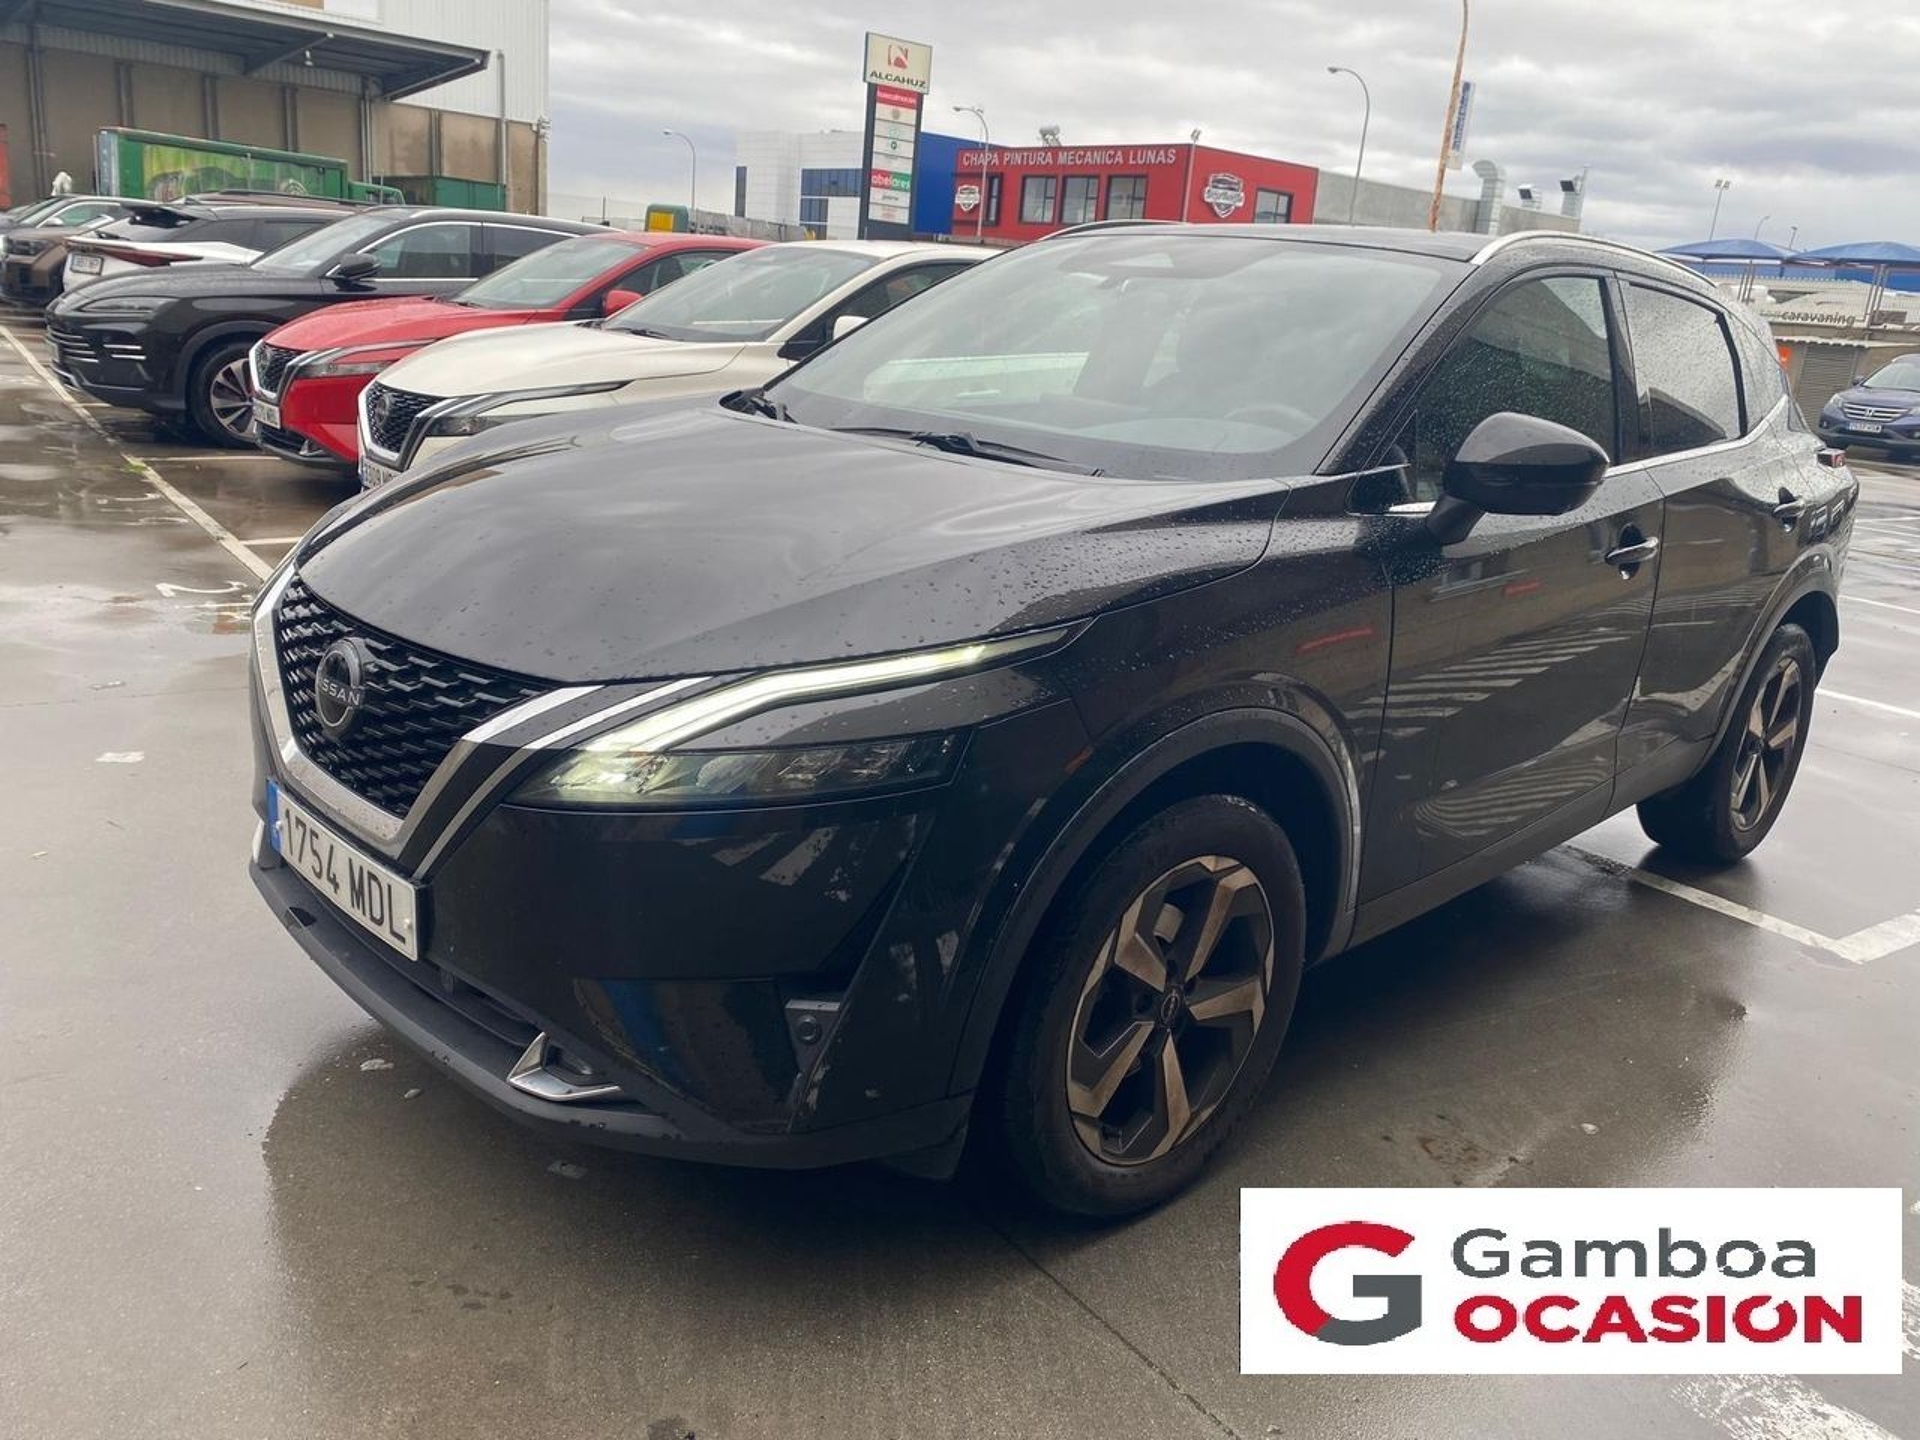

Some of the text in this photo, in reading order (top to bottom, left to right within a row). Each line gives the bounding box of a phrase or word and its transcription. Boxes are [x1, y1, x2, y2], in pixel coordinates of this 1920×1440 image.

[870, 70, 926, 89] ALCAHUZ
[962, 148, 1176, 166] CHAPA PINTURA MECANICA LUNAS
[1781, 311, 1856, 327] caravaning
[285, 808, 406, 944] 1754 MDL
